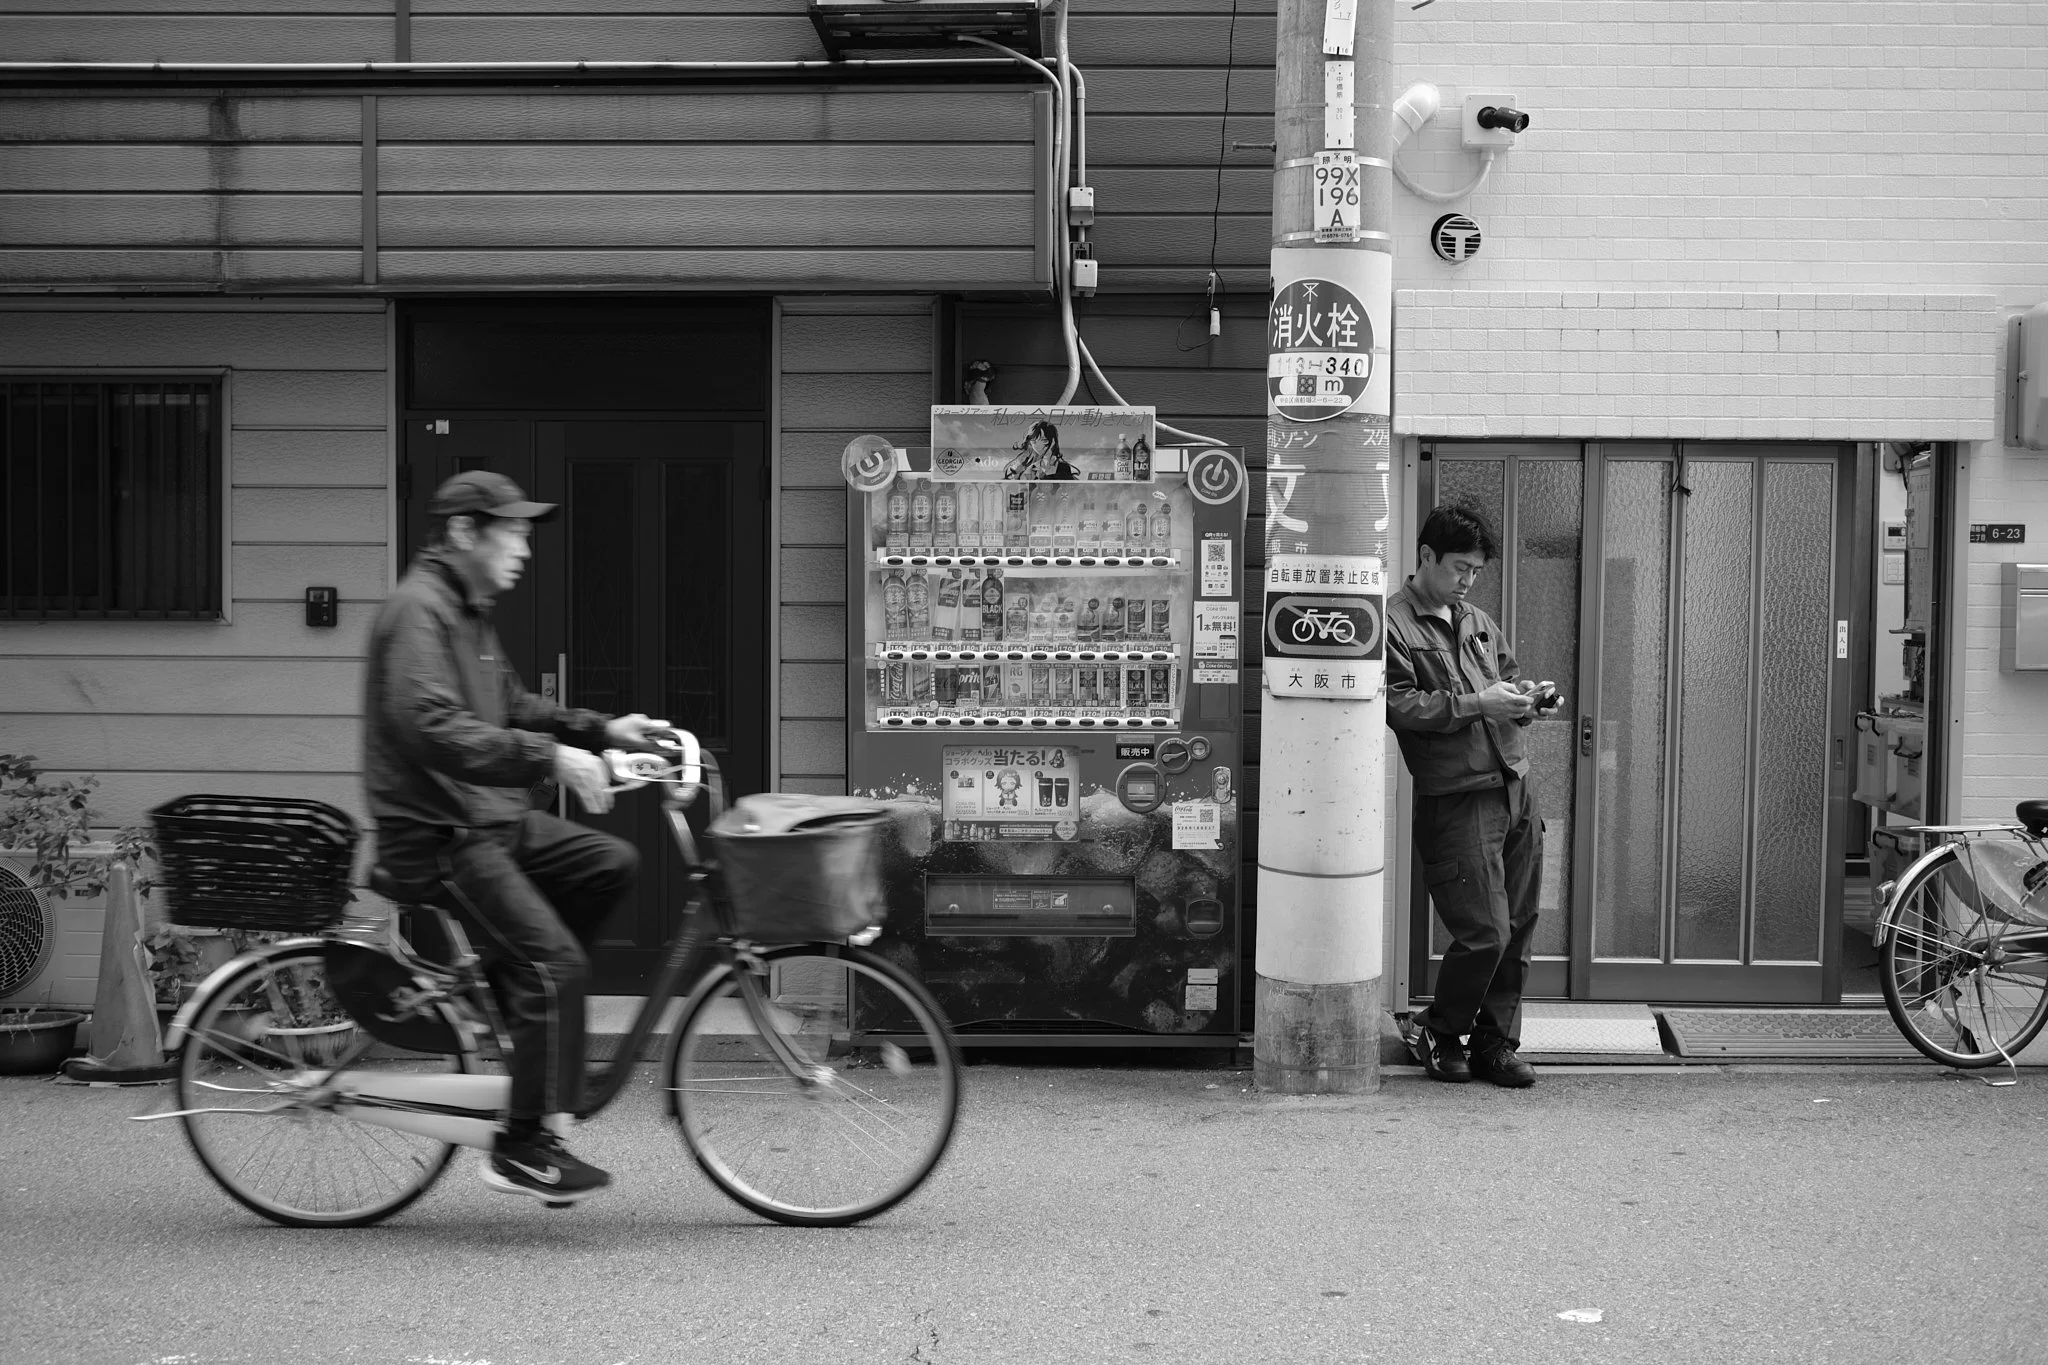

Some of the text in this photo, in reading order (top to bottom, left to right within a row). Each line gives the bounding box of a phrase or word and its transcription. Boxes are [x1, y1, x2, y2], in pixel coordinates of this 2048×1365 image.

[1315, 167, 1358, 186] 99X
[1320, 187, 1358, 206] 196
[1330, 208, 1344, 226] A
[1273, 303, 1360, 348] 消火栓
[1325, 380, 1340, 391] m
[1992, 528, 2020, 539] 6-23
[1271, 568, 1380, 586] 自転車放置禁止区域
[982, 604, 1002, 614] BLACK
[1839, 625, 1847, 654] 出入口
[1288, 673, 1356, 689] 大阪市
[993, 748, 1046, 766] 当たる!
[1121, 747, 1150, 757] 販売中
